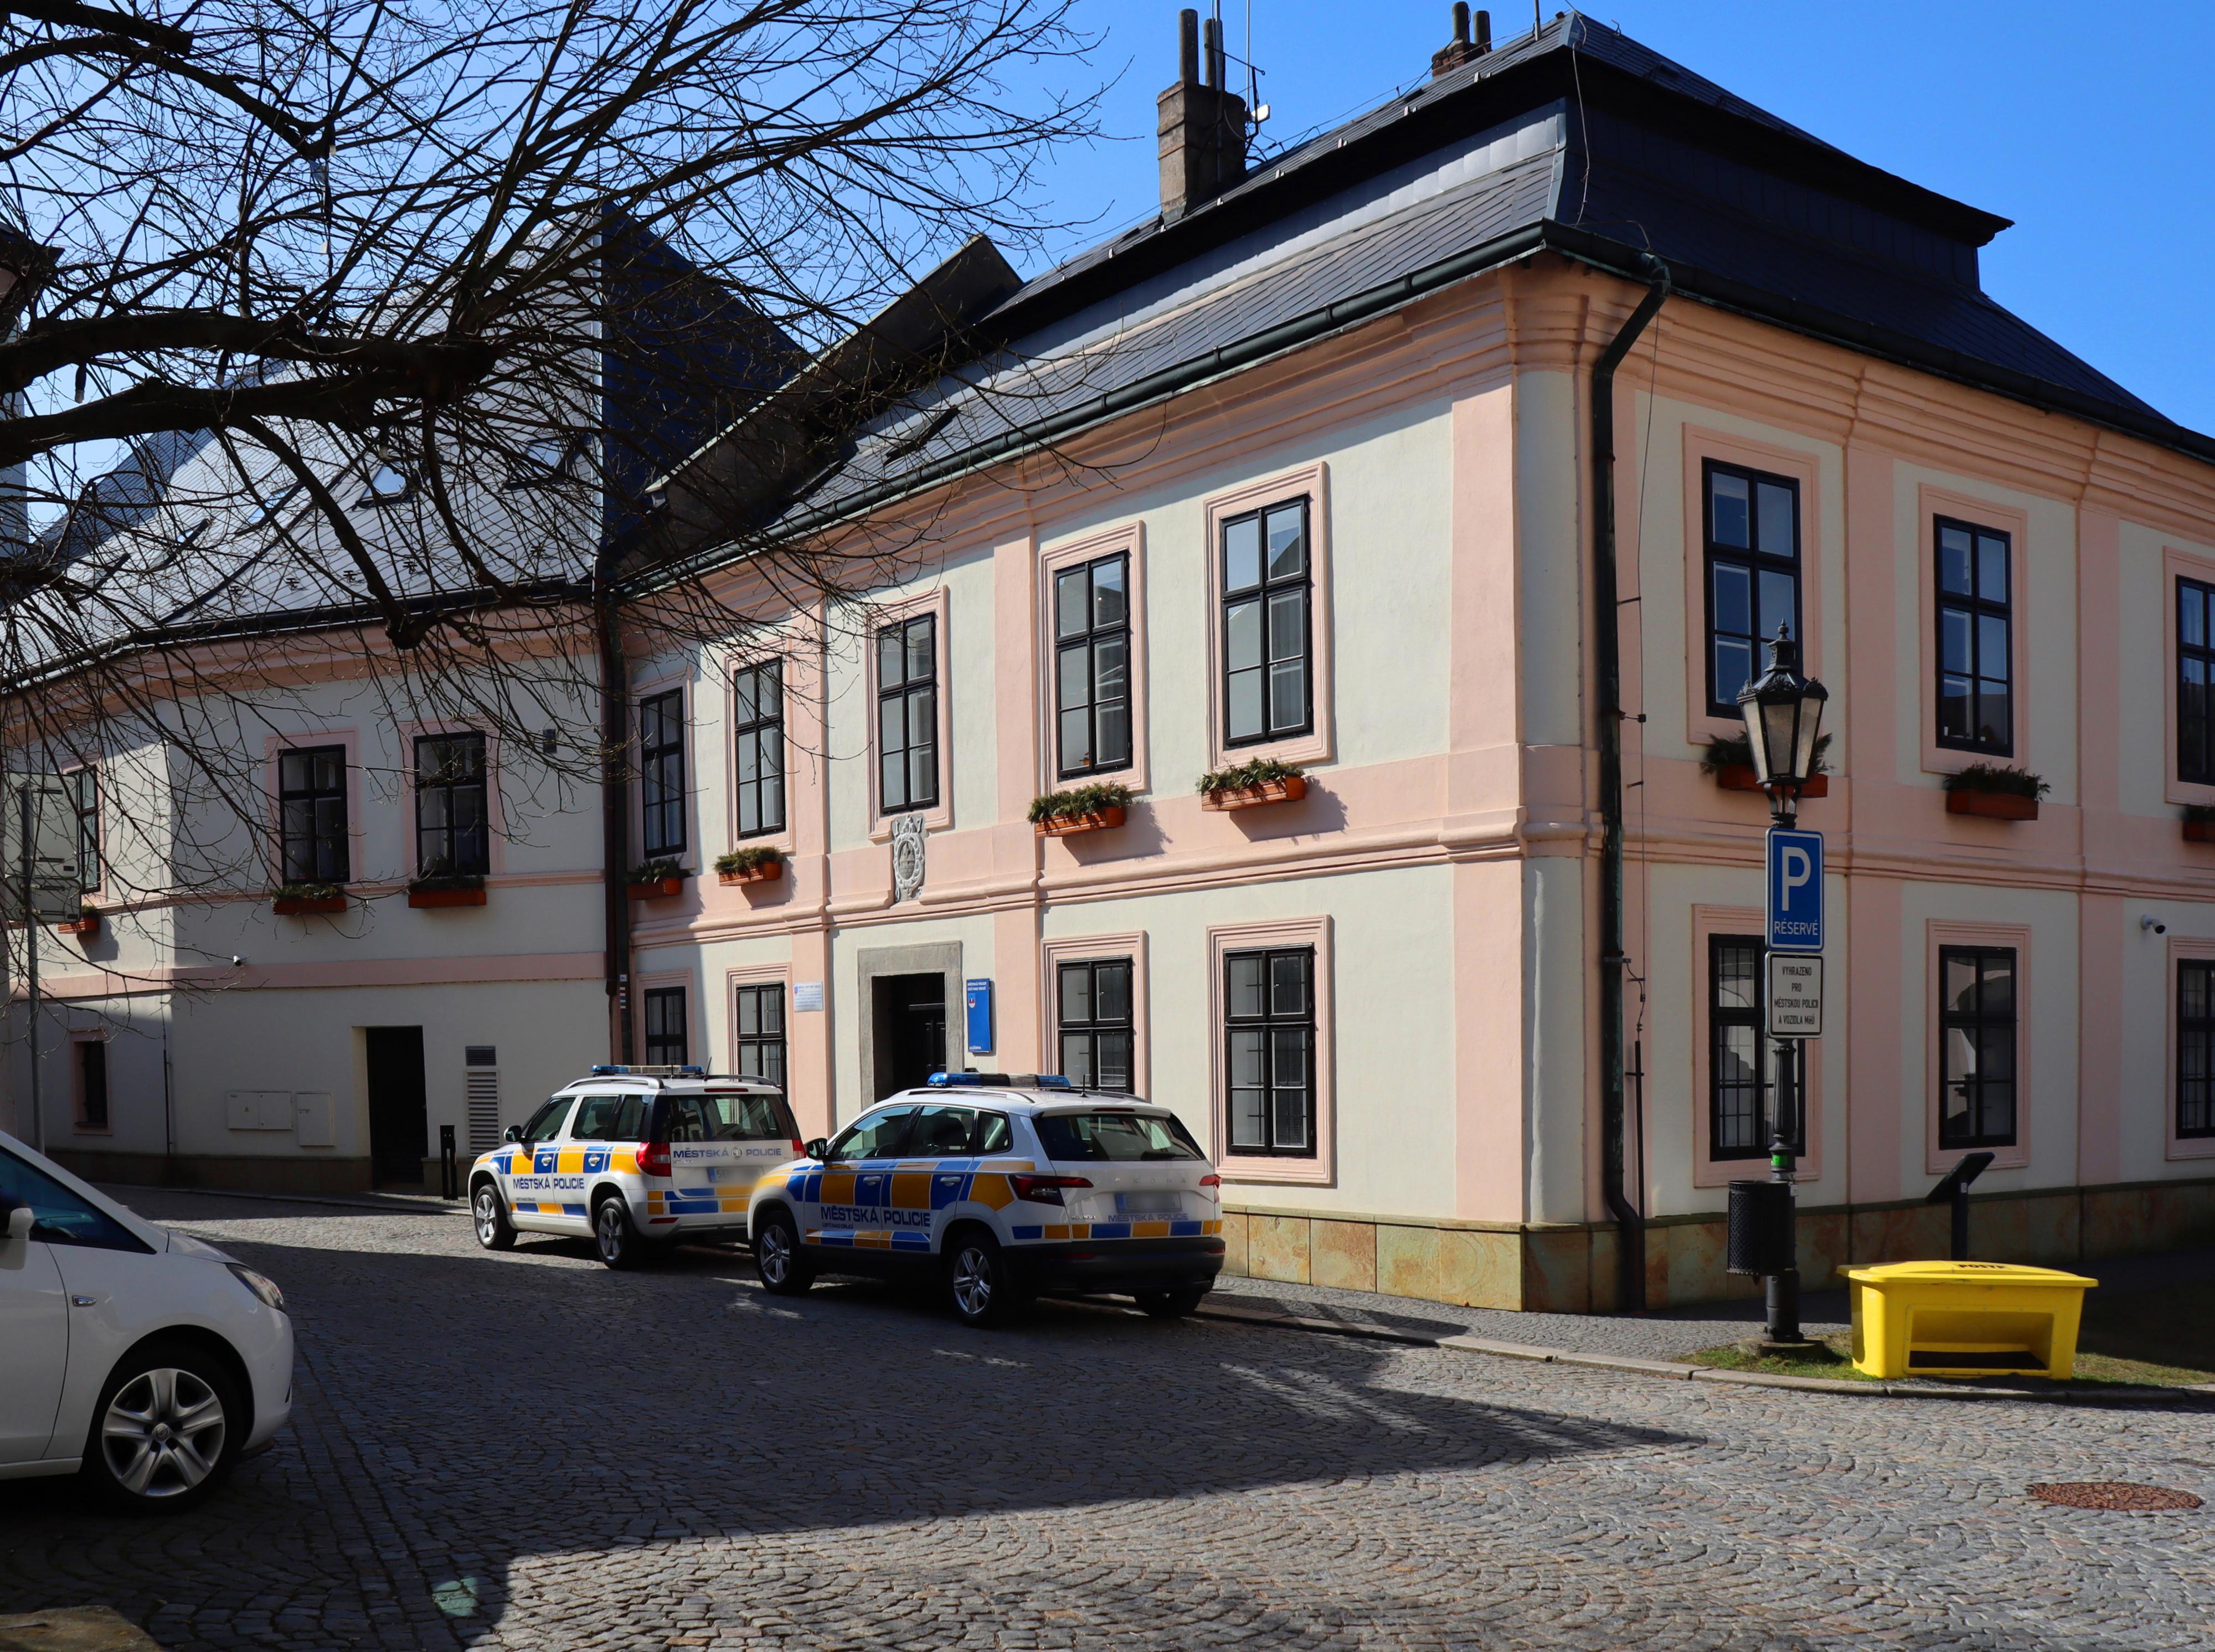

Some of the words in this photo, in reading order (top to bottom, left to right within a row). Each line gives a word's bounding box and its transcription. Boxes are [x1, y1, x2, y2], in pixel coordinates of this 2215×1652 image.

[1782, 846, 1811, 912] P
[1774, 918, 1819, 936] RÉSERVÉ
[1782, 966, 1812, 976] VYHRAZENO
[1791, 983, 1802, 992] PRO
[1774, 997, 1800, 1008] MĚSTSKOU
[1779, 1015, 1783, 1024] A
[1784, 1015, 1803, 1025] VOZIDLA
[673, 1147, 729, 1159] MĚSTSKÁ
[746, 1148, 781, 1156] POLICIE
[513, 1176, 551, 1190] MĚSTSKÁ
[553, 1177, 585, 1190] POLICIE
[821, 1205, 879, 1223] MĚSTSKÁ
[884, 1210, 931, 1227] POLICIE
[1108, 1213, 1152, 1222] MĚSTSKÁ
[1158, 1213, 1188, 1221] POLICIE
